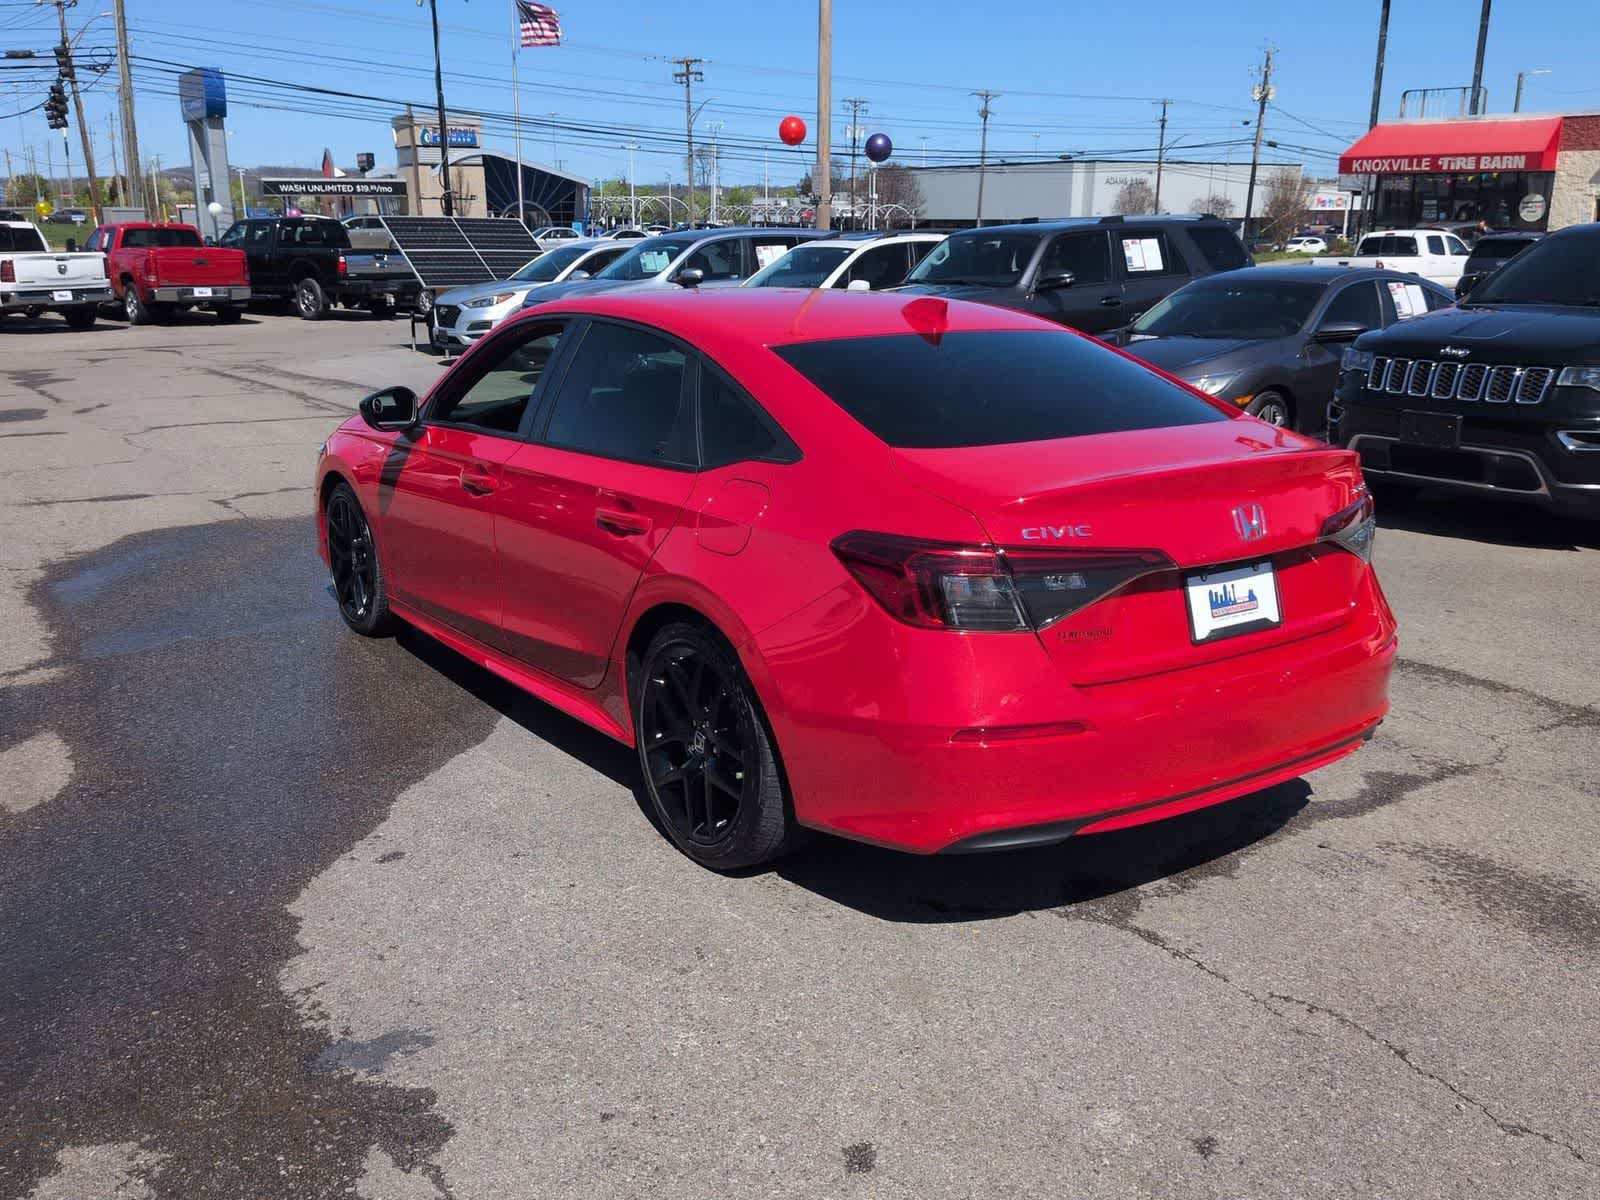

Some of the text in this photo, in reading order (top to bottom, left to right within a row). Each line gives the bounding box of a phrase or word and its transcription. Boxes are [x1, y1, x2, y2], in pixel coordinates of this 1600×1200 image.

[1352, 155, 1526, 172] KNOXVILLE TIRE BARN
[279, 184, 306, 193] WASH
[308, 184, 354, 193] UNLIMITED
[1021, 524, 1092, 541] CIVIC
